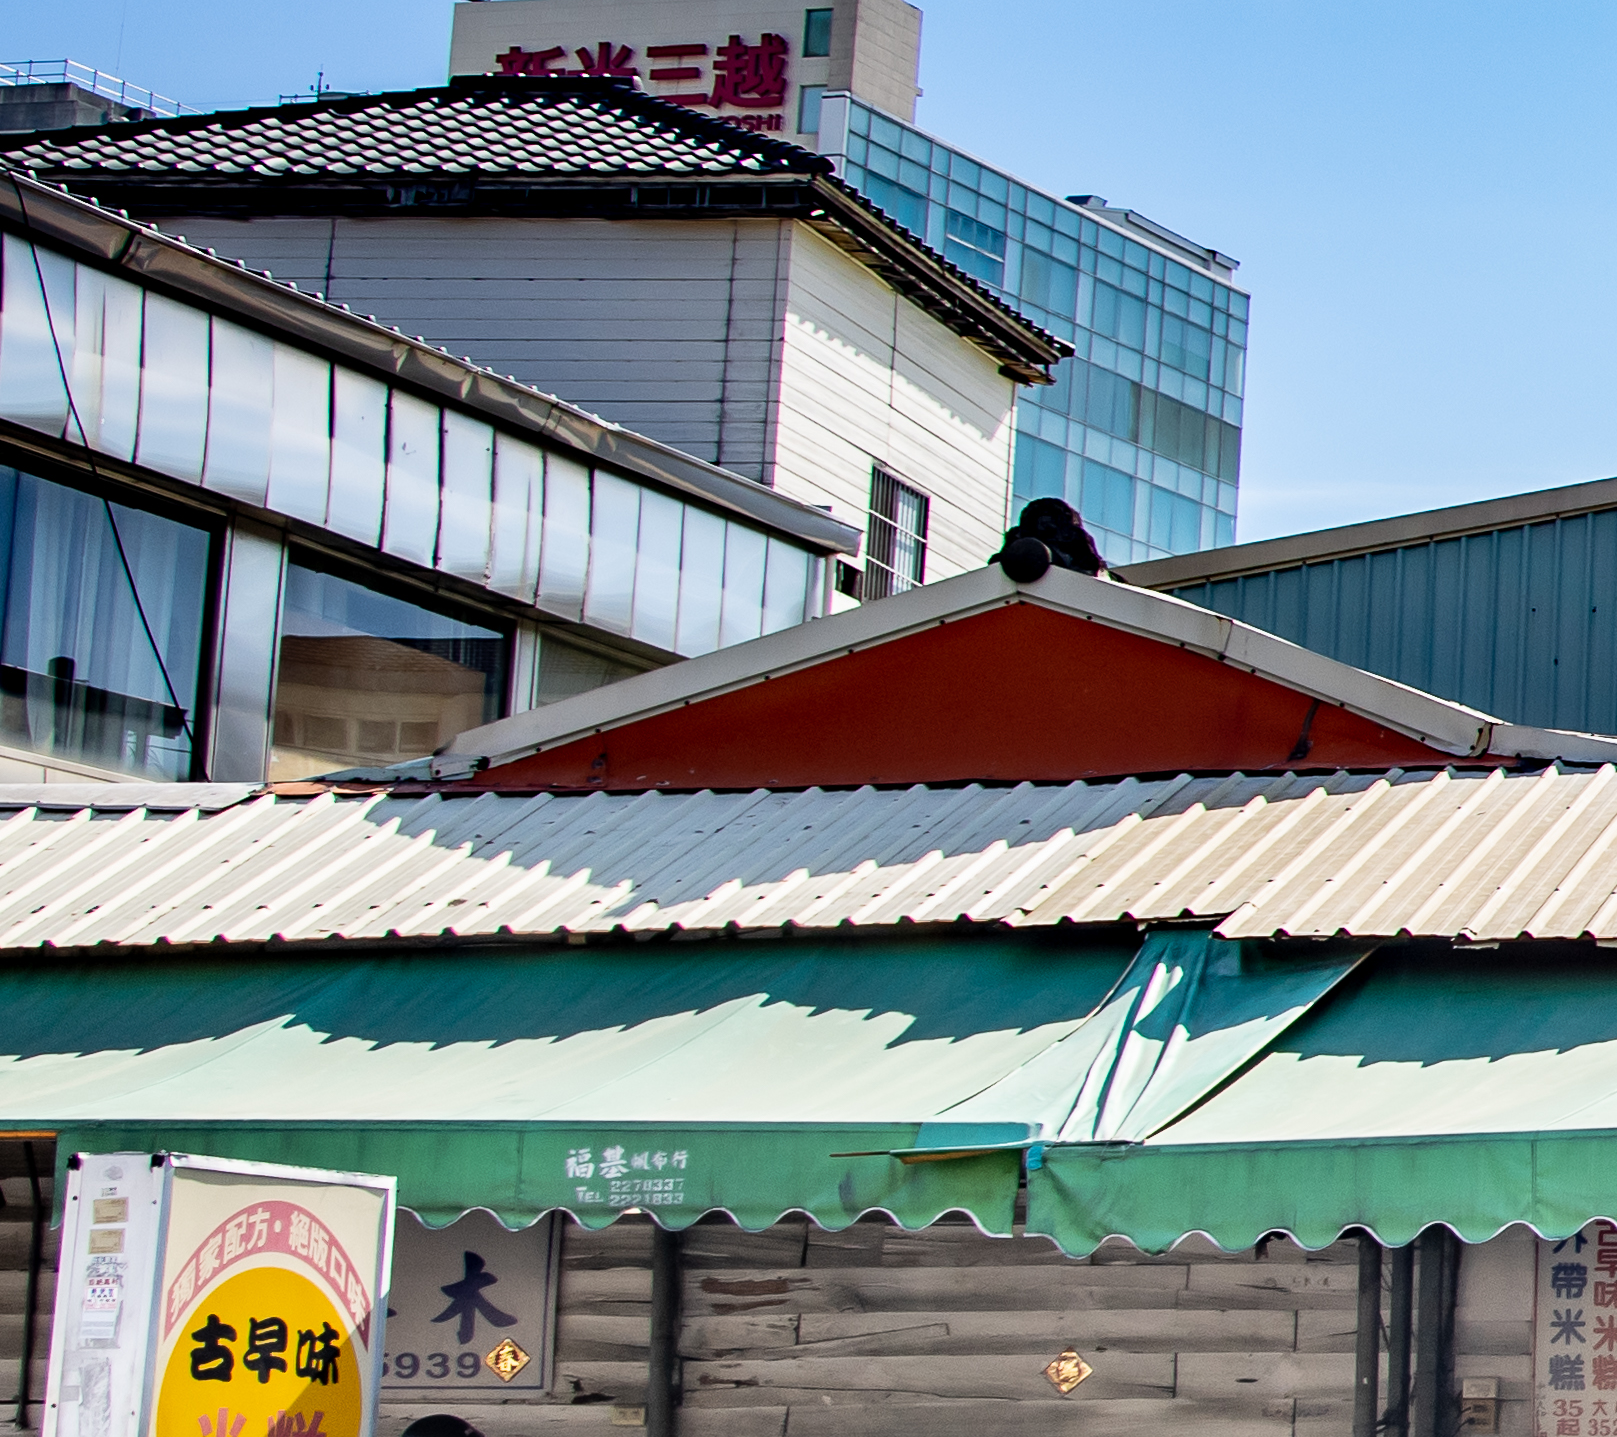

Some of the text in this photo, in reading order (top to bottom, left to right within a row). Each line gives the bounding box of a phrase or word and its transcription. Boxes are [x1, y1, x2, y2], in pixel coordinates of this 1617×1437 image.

[718, 114, 783, 133] OSHI
[566, 1145, 689, 1180] 福基帆布行
[190, 1313, 341, 1386] 古早味
[495, 1345, 520, 1372] 春
[382, 1351, 481, 1379] 939
[1553, 1399, 1584, 1418] 35
[1556, 1418, 1581, 1437] 起
